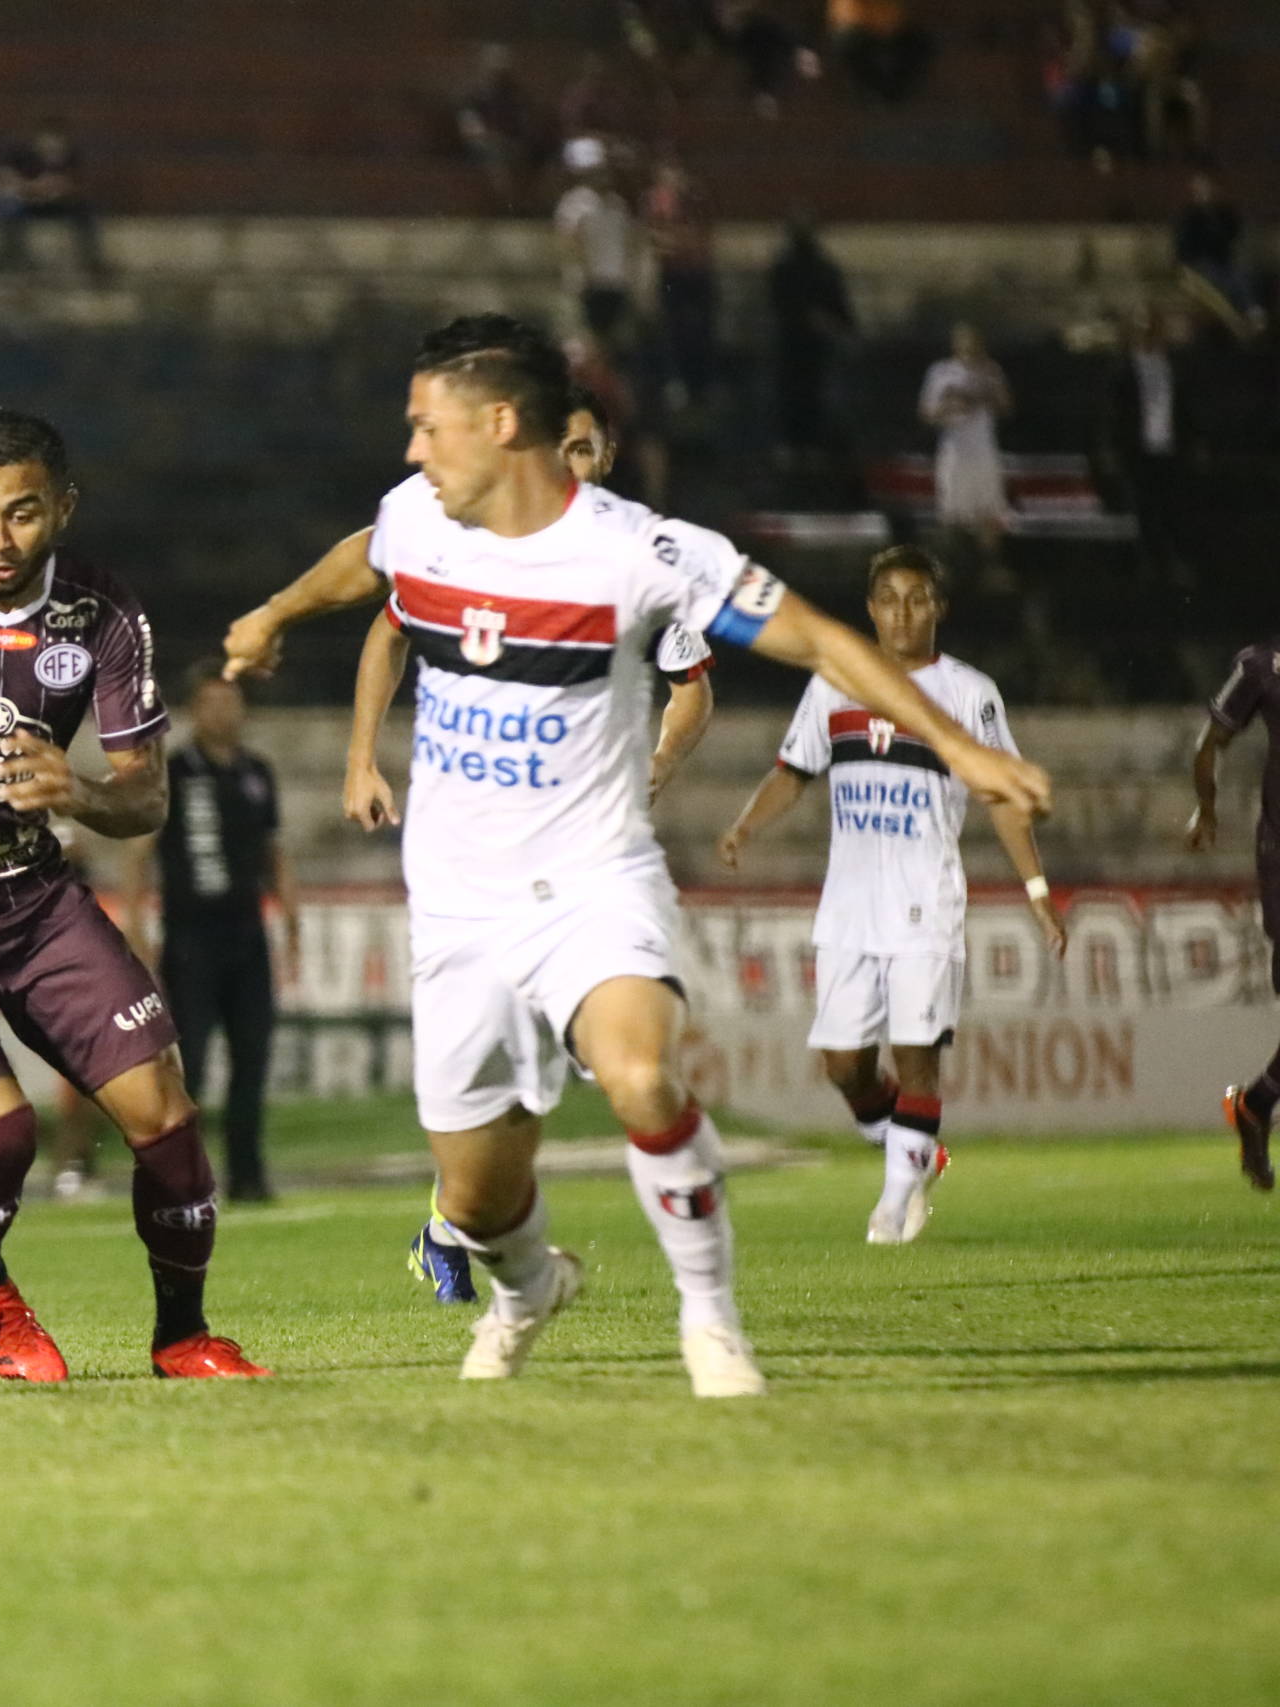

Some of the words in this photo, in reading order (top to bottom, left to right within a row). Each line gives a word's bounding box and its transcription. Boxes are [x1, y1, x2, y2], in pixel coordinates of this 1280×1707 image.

[43, 651, 82, 681] AFE
[417, 734, 561, 789] nvest.
[836, 810, 922, 838] ivest.
